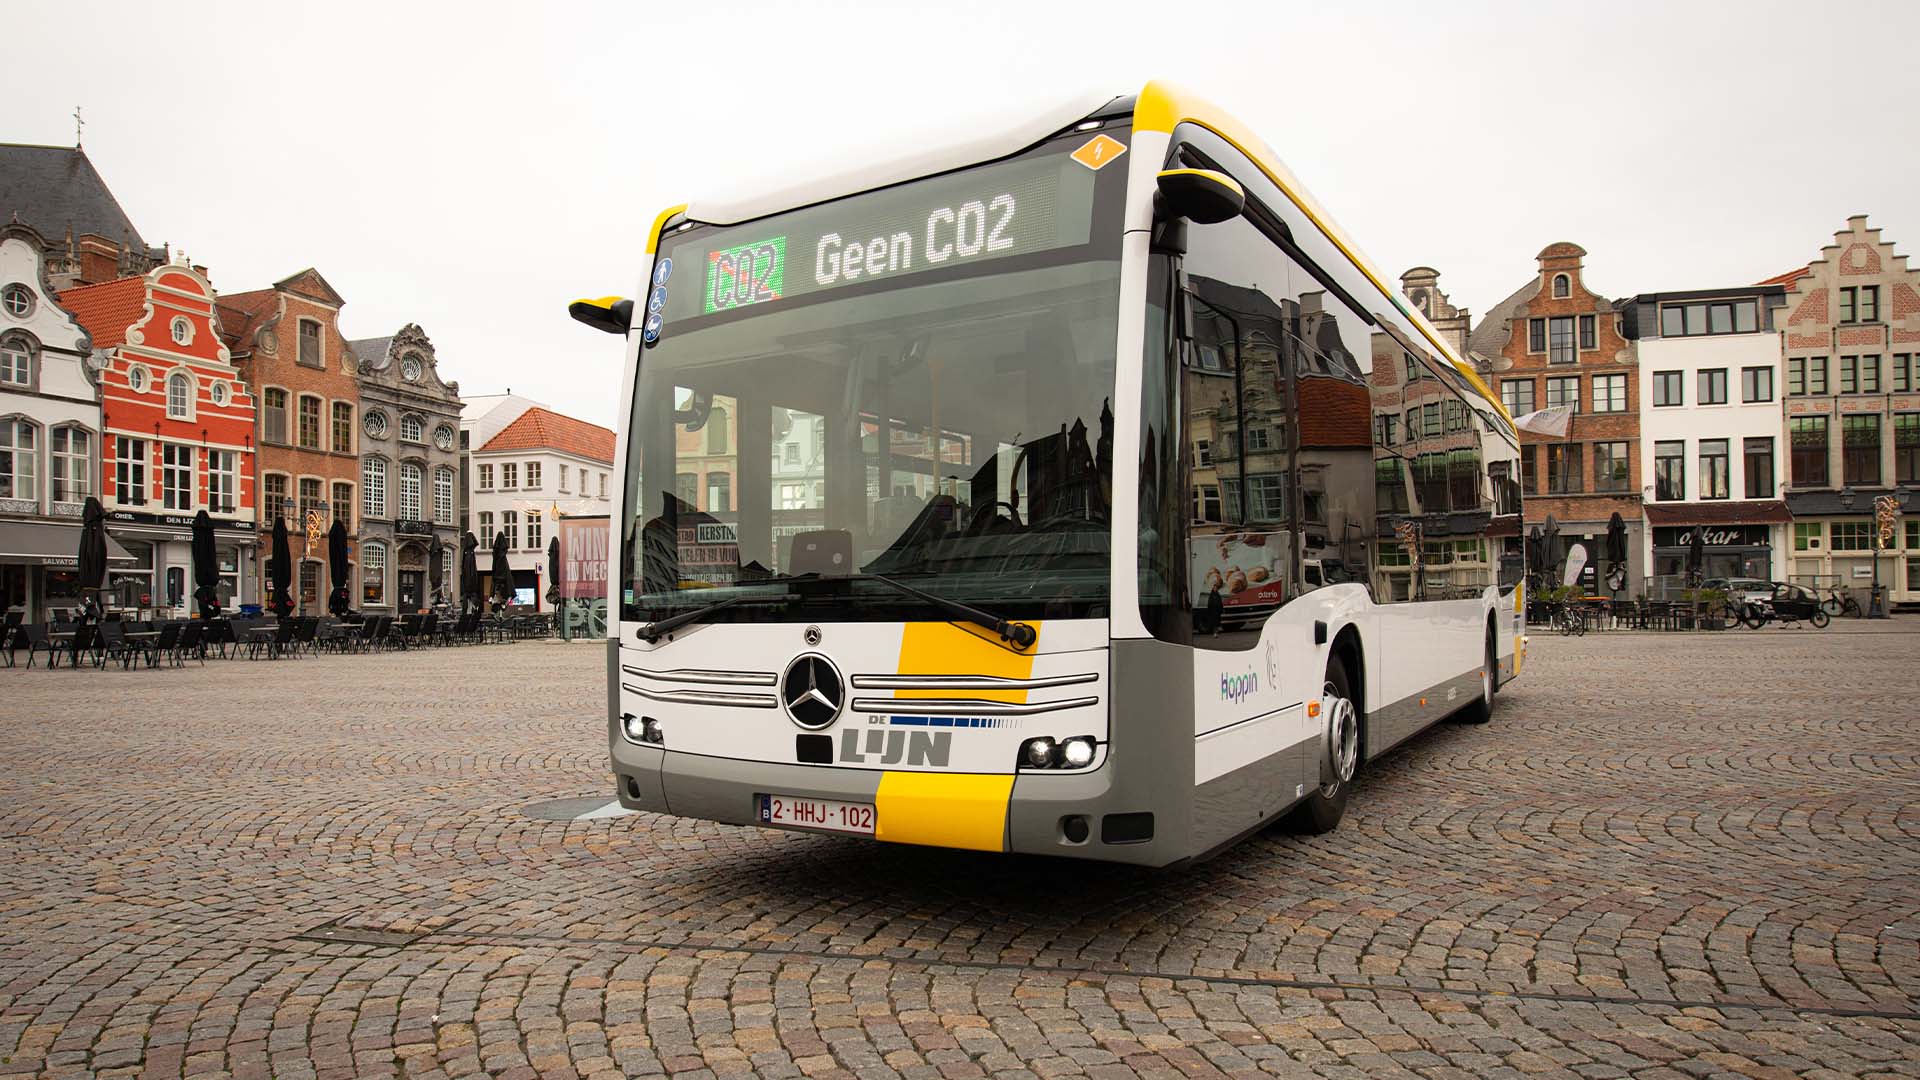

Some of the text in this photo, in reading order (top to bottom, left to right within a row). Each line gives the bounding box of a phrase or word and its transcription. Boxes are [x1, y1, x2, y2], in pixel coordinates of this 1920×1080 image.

[815, 193, 1016, 285] Geen CO2
[713, 244, 778, 311] CO2
[566, 527, 609, 561] WIN
[700, 526, 737, 542] KERSTM
[582, 561, 608, 582] MEC
[1221, 664, 1258, 705] Hoppin
[868, 715, 887, 725] DE
[762, 809, 770, 819] B
